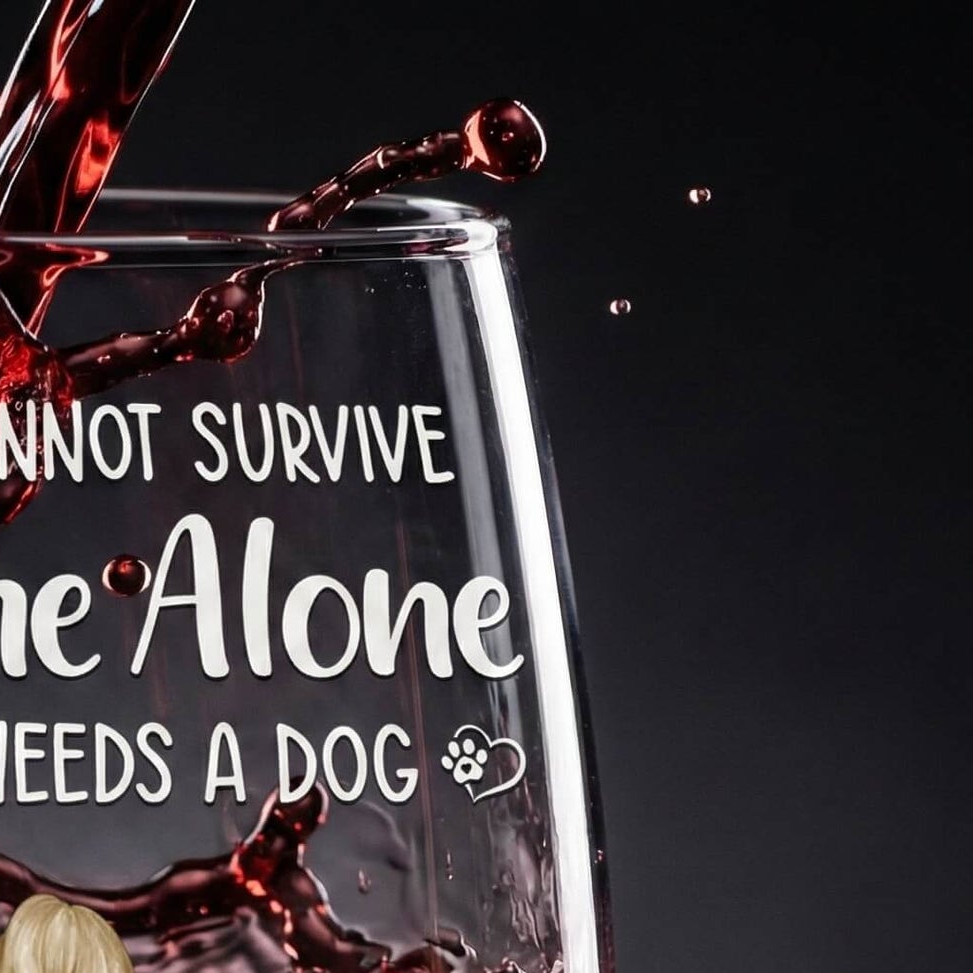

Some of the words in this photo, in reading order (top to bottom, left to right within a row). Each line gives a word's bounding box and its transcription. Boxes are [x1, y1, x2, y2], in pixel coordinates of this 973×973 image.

[191, 401, 456, 484] SURVIVE
[130, 513, 526, 679] Alone
[203, 721, 246, 803] A
[276, 723, 420, 803] DOG
